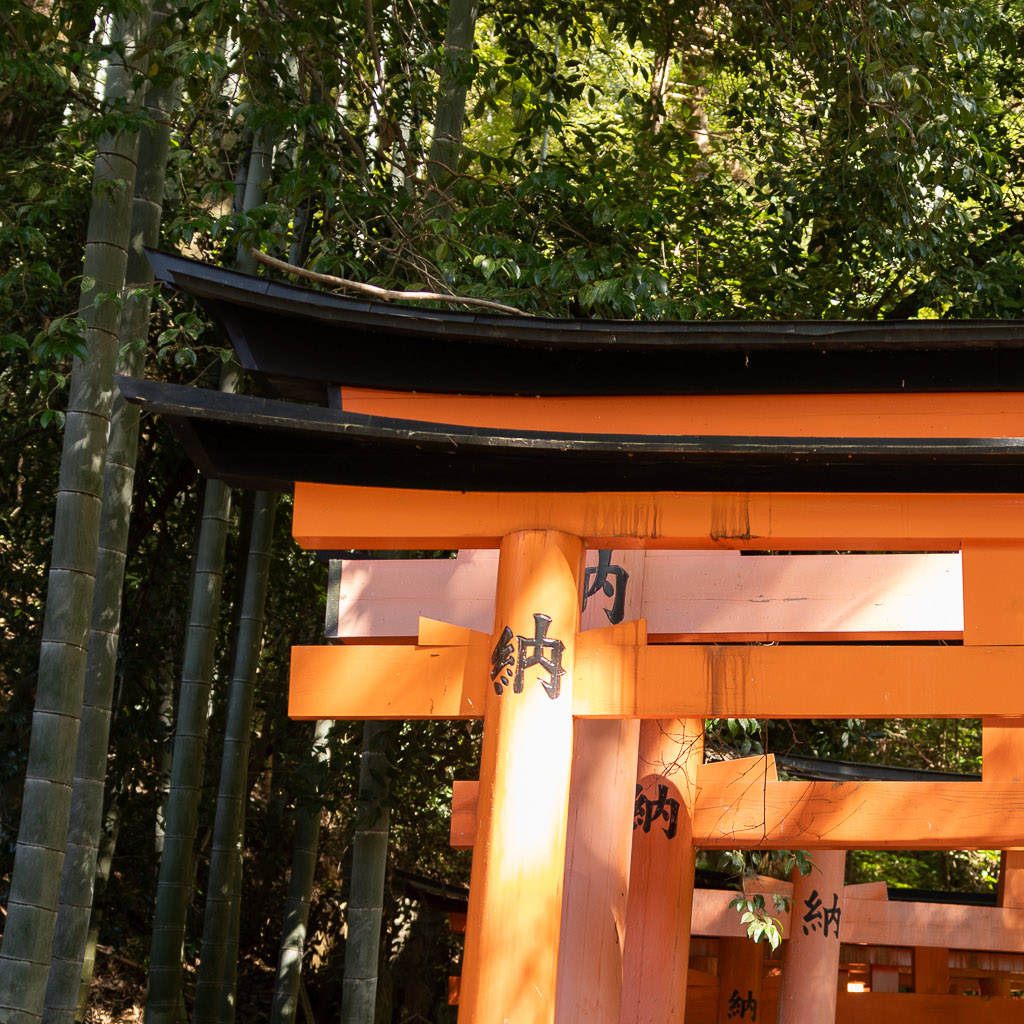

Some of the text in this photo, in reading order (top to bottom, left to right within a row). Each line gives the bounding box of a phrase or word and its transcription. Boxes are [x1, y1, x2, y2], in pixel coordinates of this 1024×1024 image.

[490, 613, 567, 700] 納
[633, 784, 680, 840] 納
[802, 889, 842, 939] 納
[727, 988, 758, 1023] 納
